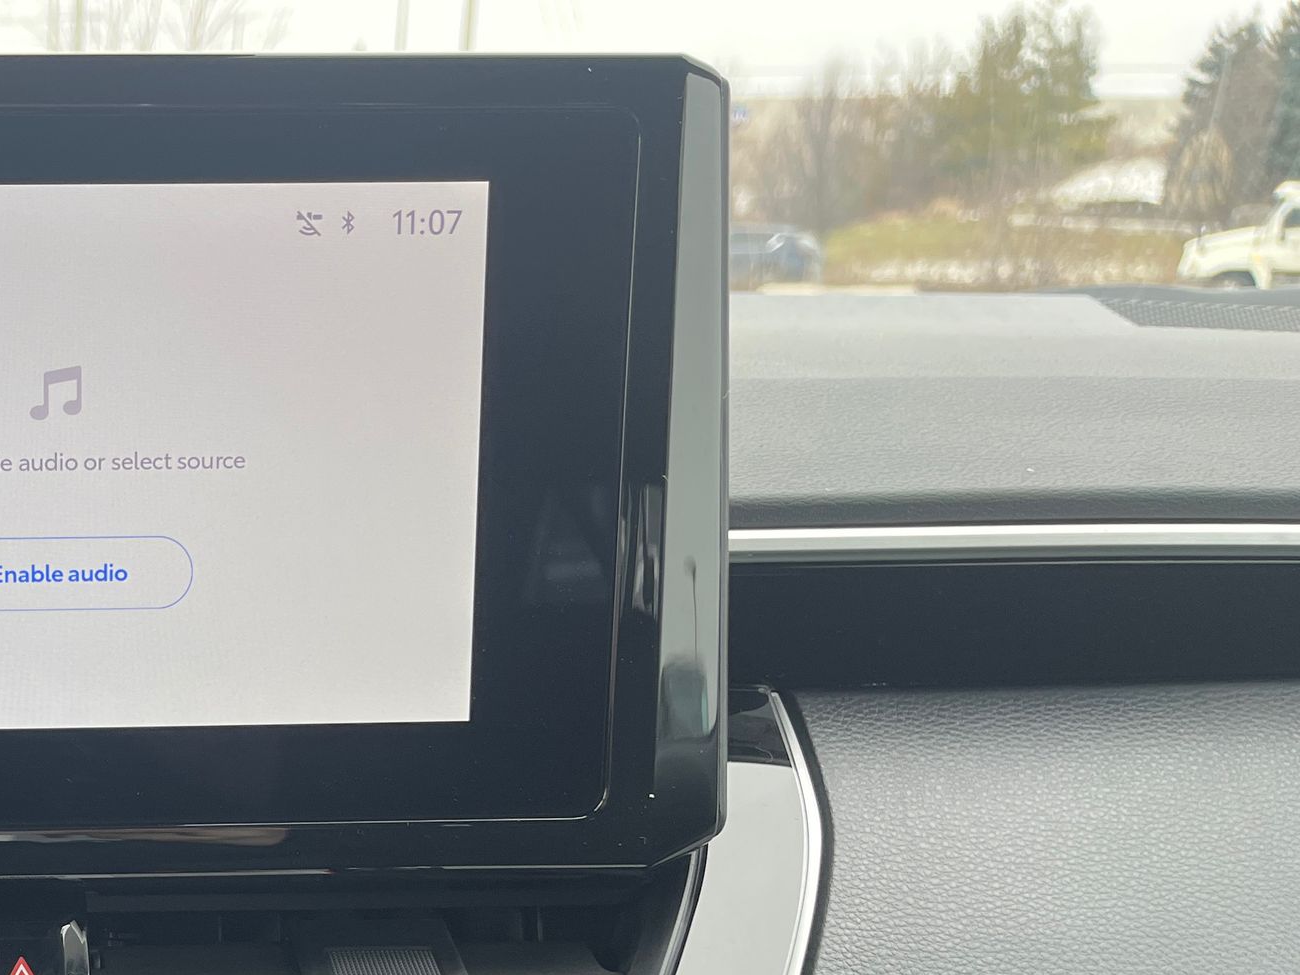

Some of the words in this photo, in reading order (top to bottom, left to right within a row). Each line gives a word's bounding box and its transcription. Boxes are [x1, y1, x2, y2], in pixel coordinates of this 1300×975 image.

[392, 210, 463, 236] 11:07
[18, 452, 78, 472] audio
[83, 455, 106, 472] or
[111, 451, 172, 472] select
[176, 453, 246, 470] source
[68, 563, 128, 583] audio
